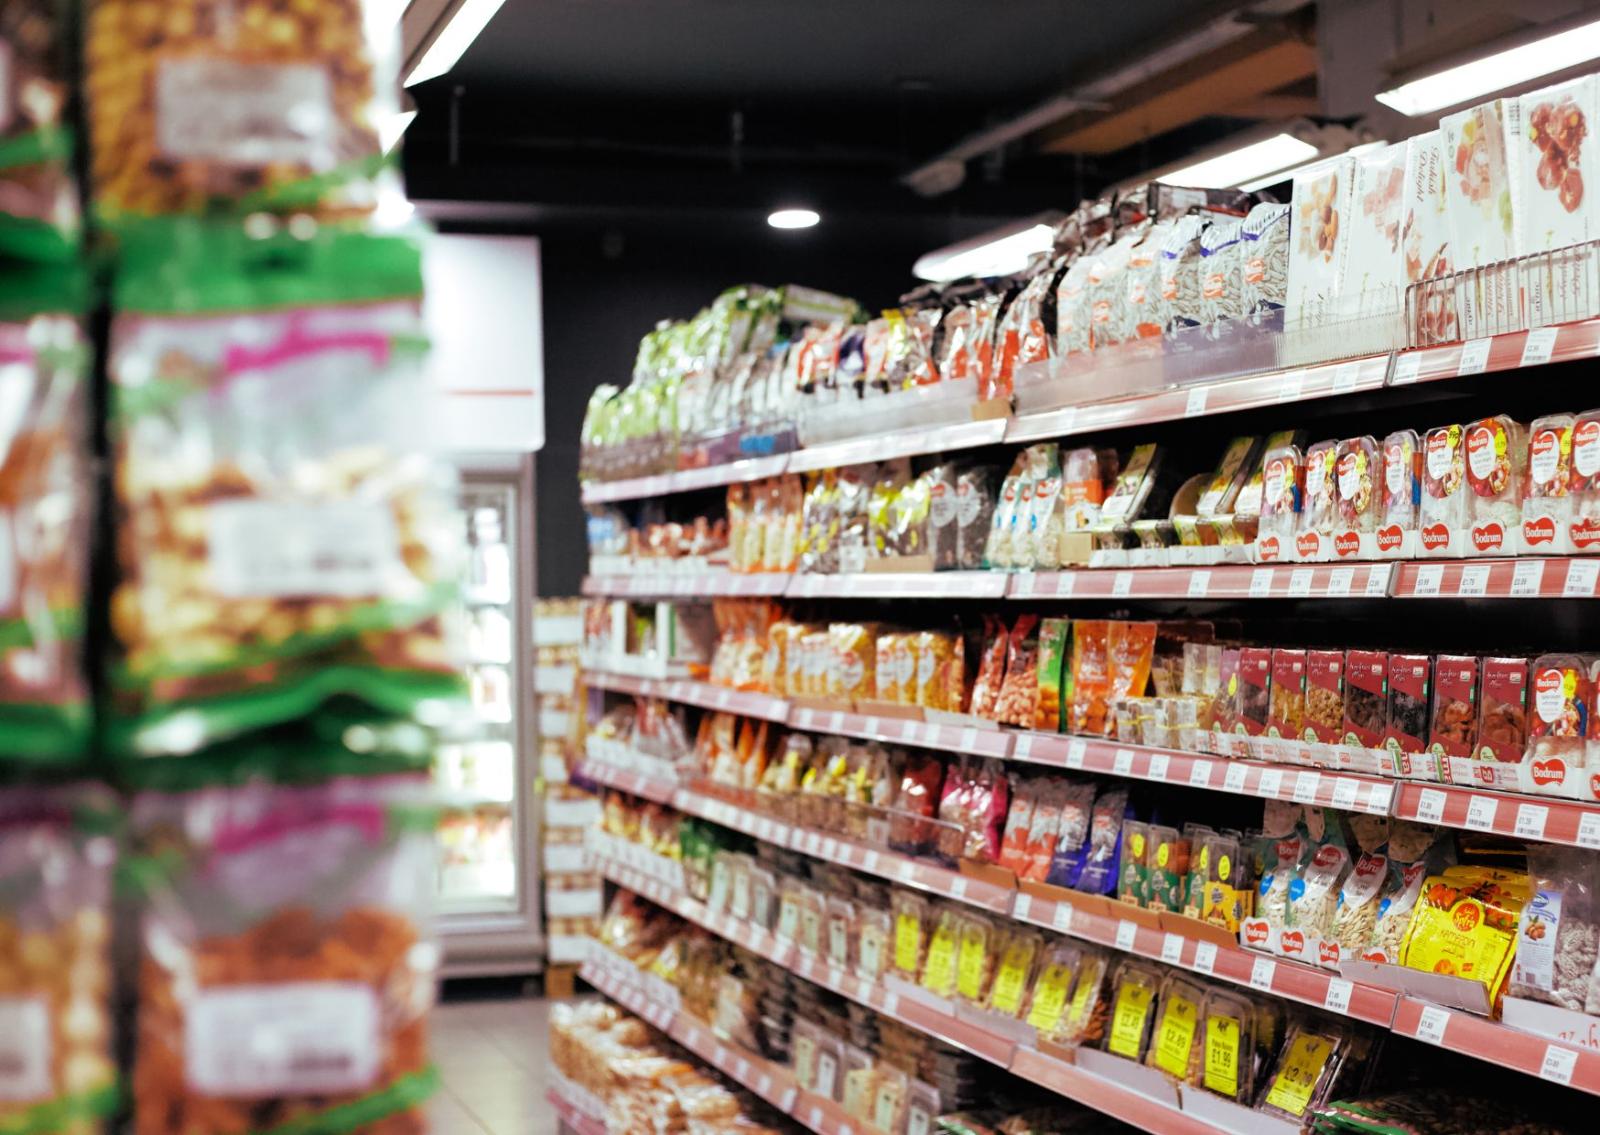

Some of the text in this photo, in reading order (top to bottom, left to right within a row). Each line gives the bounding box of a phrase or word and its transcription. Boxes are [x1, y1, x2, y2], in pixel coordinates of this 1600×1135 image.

[1427, 146, 1440, 195] Turkish
[1415, 151, 1428, 202] Delight
[1423, 532, 1448, 543] Bodrum
[1475, 532, 1501, 543] Bodrum
[1525, 526, 1553, 538] Bodrum
[1336, 540, 1359, 550] Bodrum
[1378, 534, 1401, 545] Bodrum
[1298, 541, 1318, 550] Bodrum
[1536, 679, 1560, 687] Bodrum
[1533, 767, 1563, 780] Bodrum
[1246, 929, 1268, 939] Bodrum
[1282, 937, 1304, 948] Bodrum
